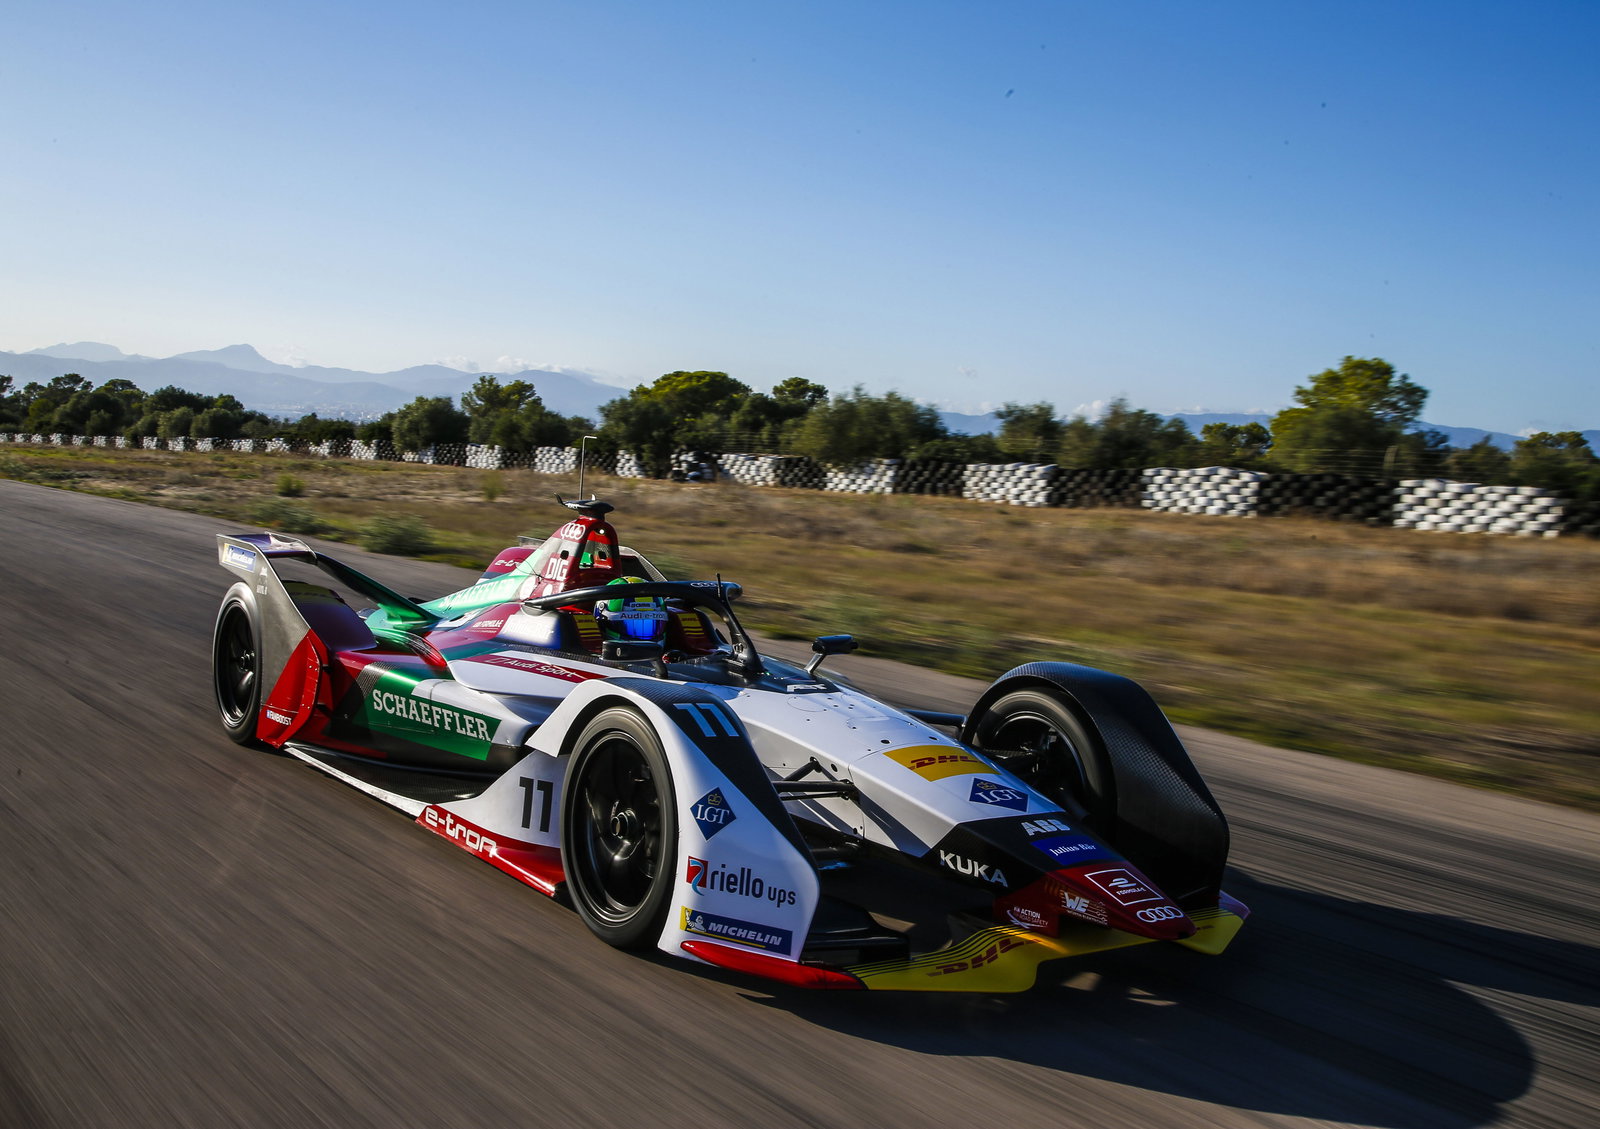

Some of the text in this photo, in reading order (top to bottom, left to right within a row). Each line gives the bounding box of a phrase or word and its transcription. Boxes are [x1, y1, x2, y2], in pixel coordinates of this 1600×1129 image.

[620, 611, 642, 620] Audi
[508, 659, 574, 678] Audi Sport
[372, 689, 492, 743] SCHAEFFLER
[673, 703, 740, 738] 11
[911, 755, 977, 769] DHL
[519, 776, 554, 833] 11
[975, 788, 1022, 804] LGT
[695, 804, 730, 825] LGT
[425, 807, 498, 857] e-tron
[1021, 819, 1070, 836] ABB
[1049, 846, 1080, 856] Julius
[939, 850, 1009, 888] KUKA
[710, 863, 796, 908] riello ups
[1020, 908, 1041, 919] ACTION
[708, 922, 782, 946] MICHELIN
